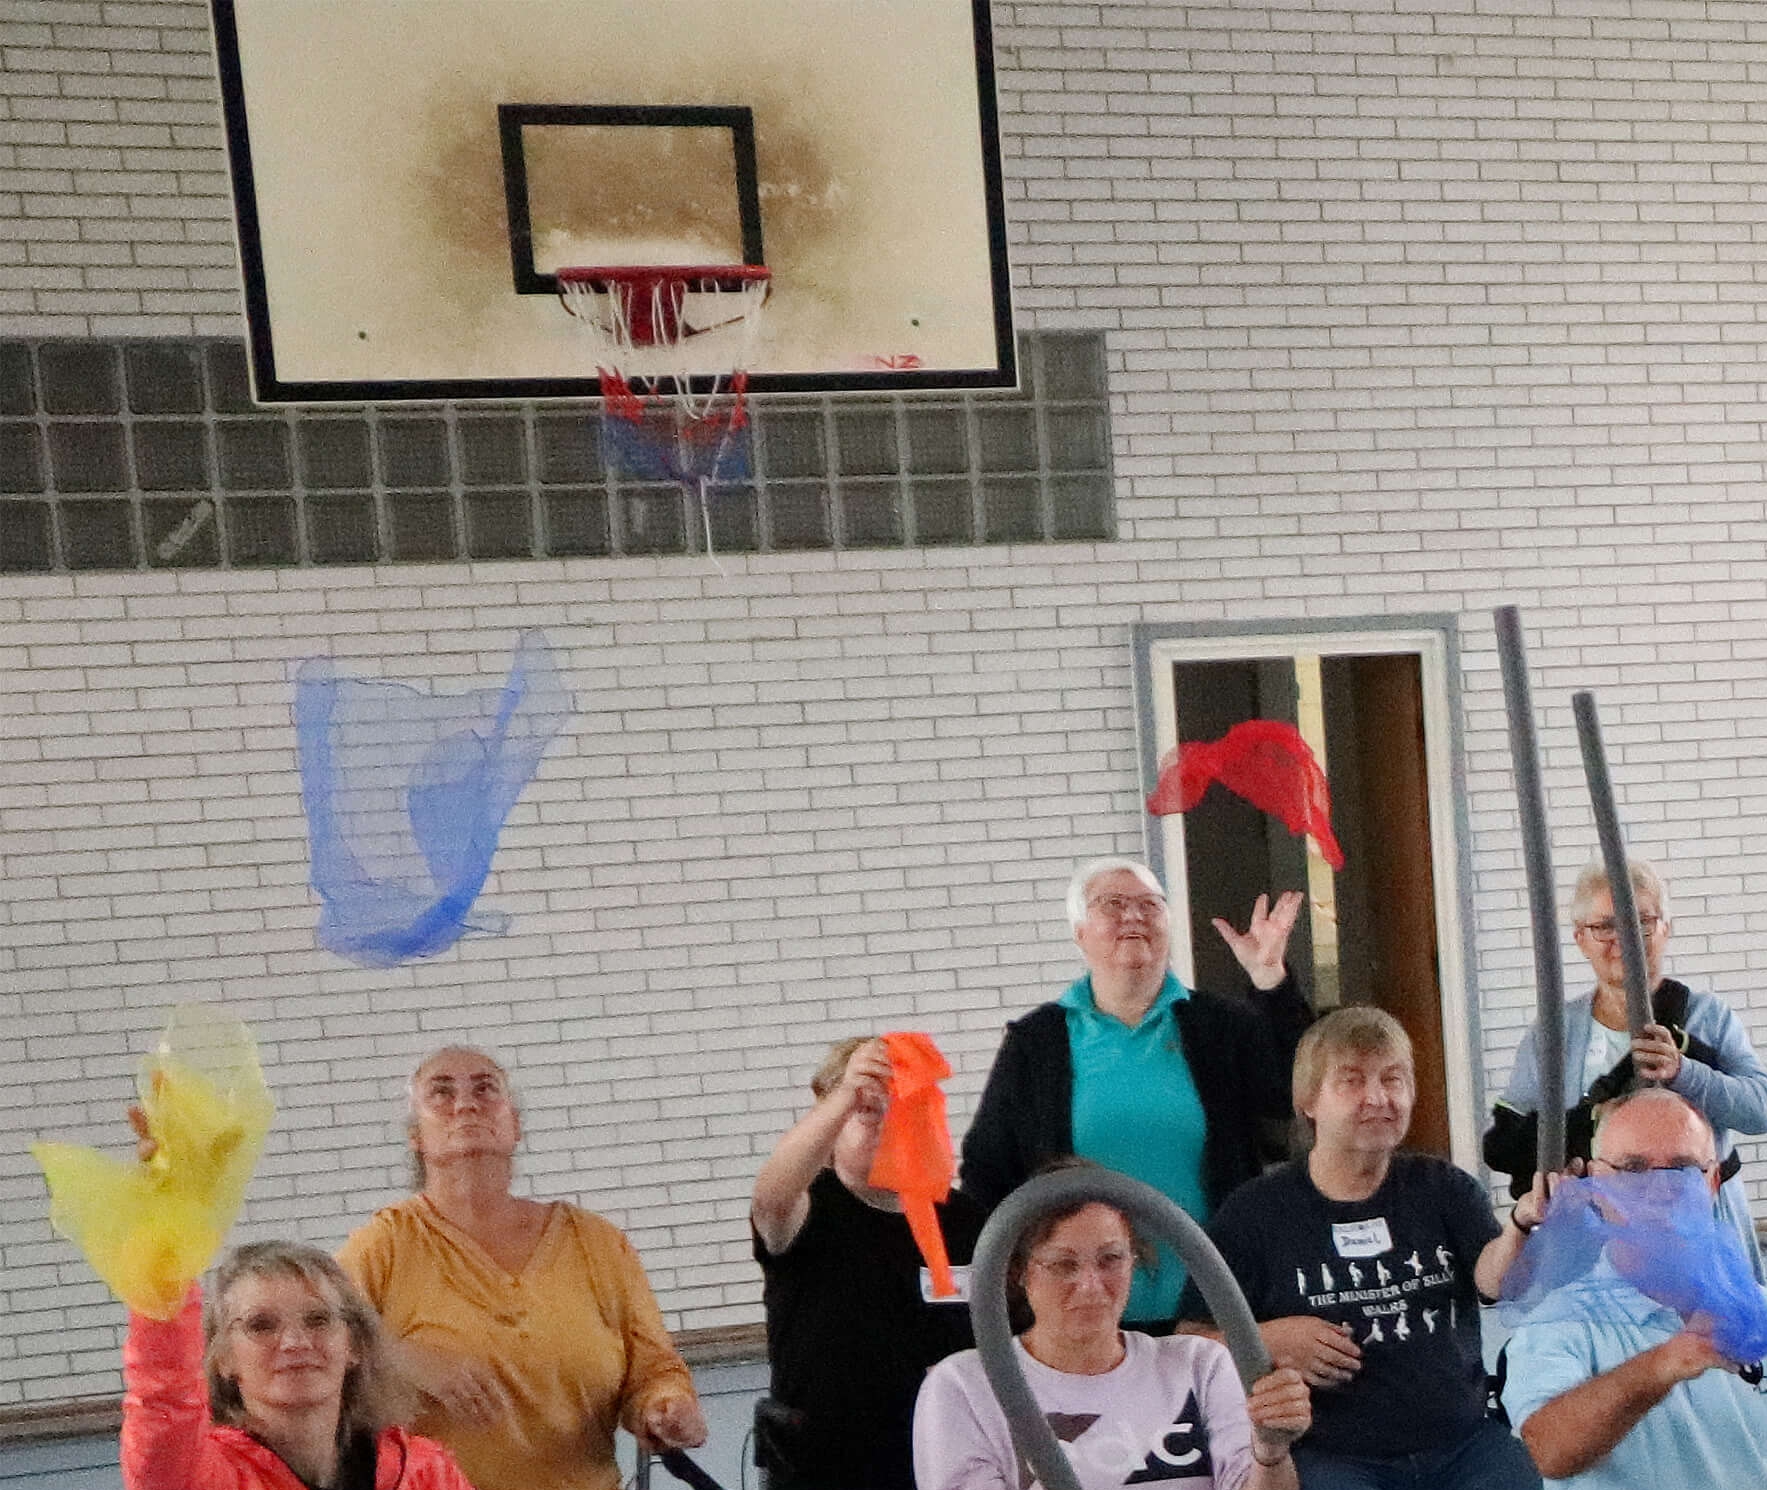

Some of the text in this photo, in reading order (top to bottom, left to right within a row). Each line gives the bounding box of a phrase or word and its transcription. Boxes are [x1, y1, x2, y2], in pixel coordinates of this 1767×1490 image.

[1308, 1293, 1336, 1307] THE
[1338, 1284, 1400, 1304] MINISTER
[1401, 1278, 1420, 1292] OF
[1361, 1299, 1409, 1317] WALKS
